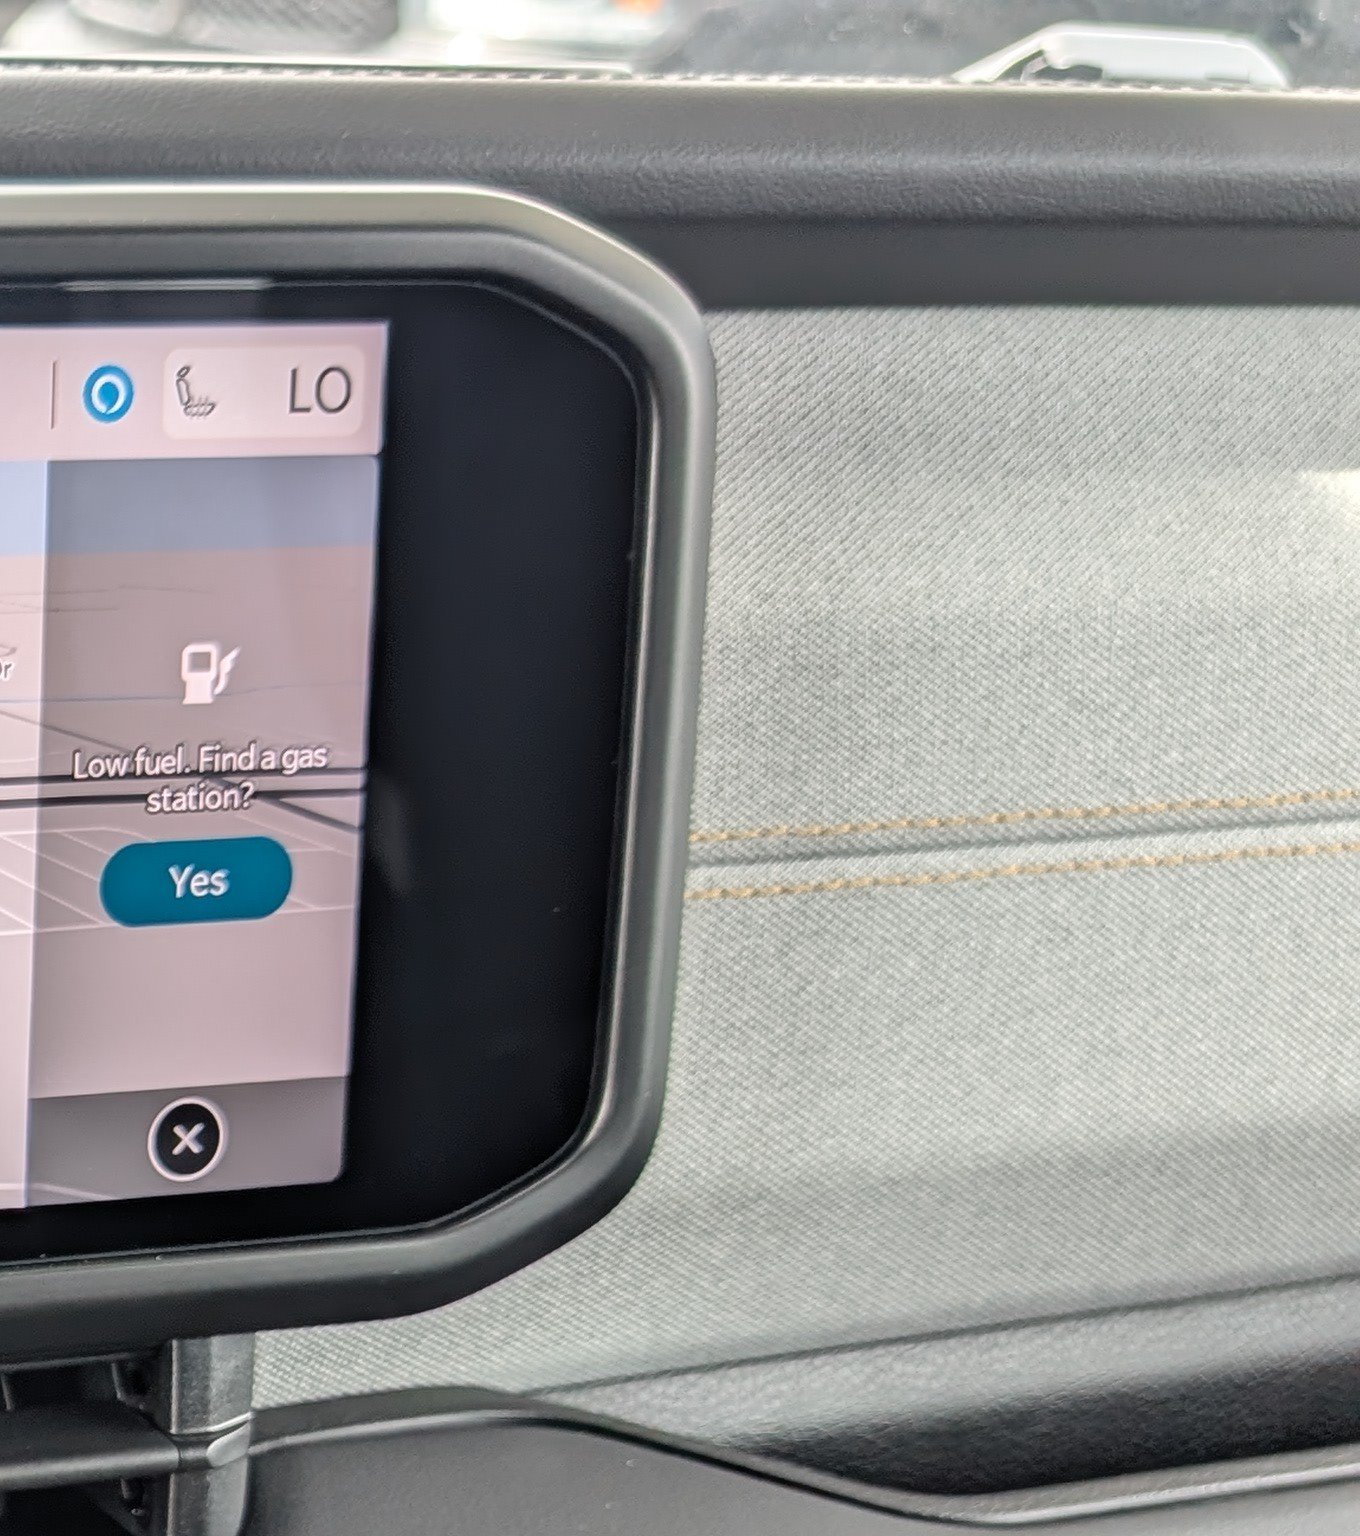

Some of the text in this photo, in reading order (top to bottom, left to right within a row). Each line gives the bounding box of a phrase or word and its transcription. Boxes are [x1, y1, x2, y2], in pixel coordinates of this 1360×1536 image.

[289, 367, 352, 414] LO
[73, 743, 328, 779] Low fuel. Find a gas
[147, 781, 255, 812] station?
[168, 864, 230, 899] Yes
